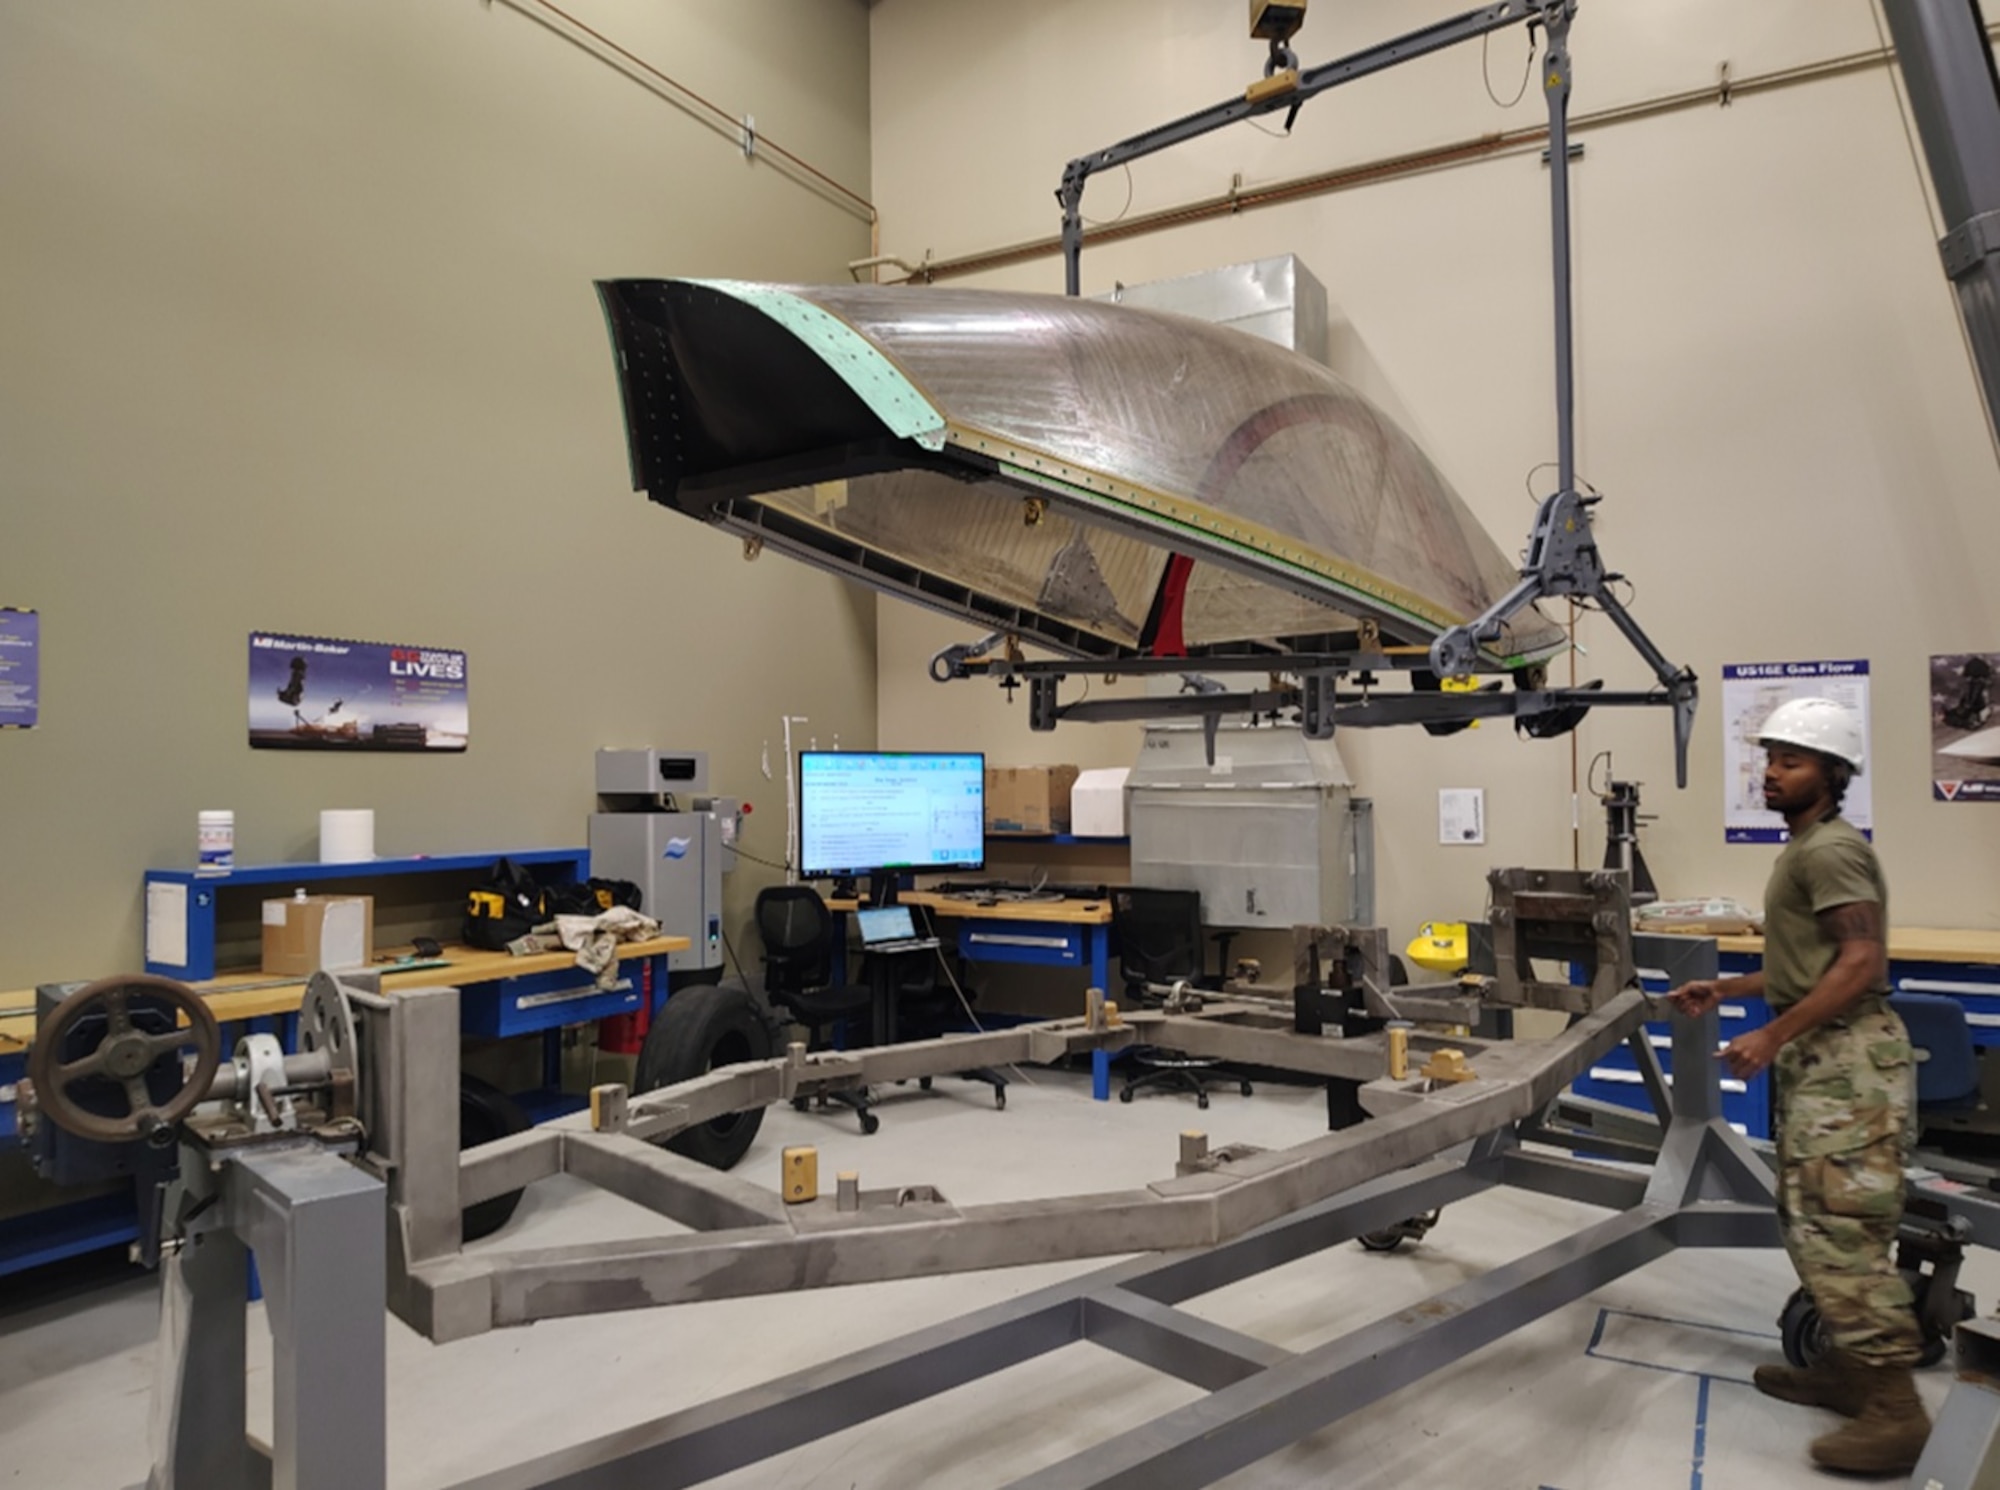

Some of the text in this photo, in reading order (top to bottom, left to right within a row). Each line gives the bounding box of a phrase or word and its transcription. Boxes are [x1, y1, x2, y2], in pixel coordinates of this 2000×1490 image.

[273, 640, 350, 654] Martin-Baker
[390, 661, 463, 679] LIVES
[1786, 663, 1816, 674] Gas
[1819, 662, 1855, 673] Flow
